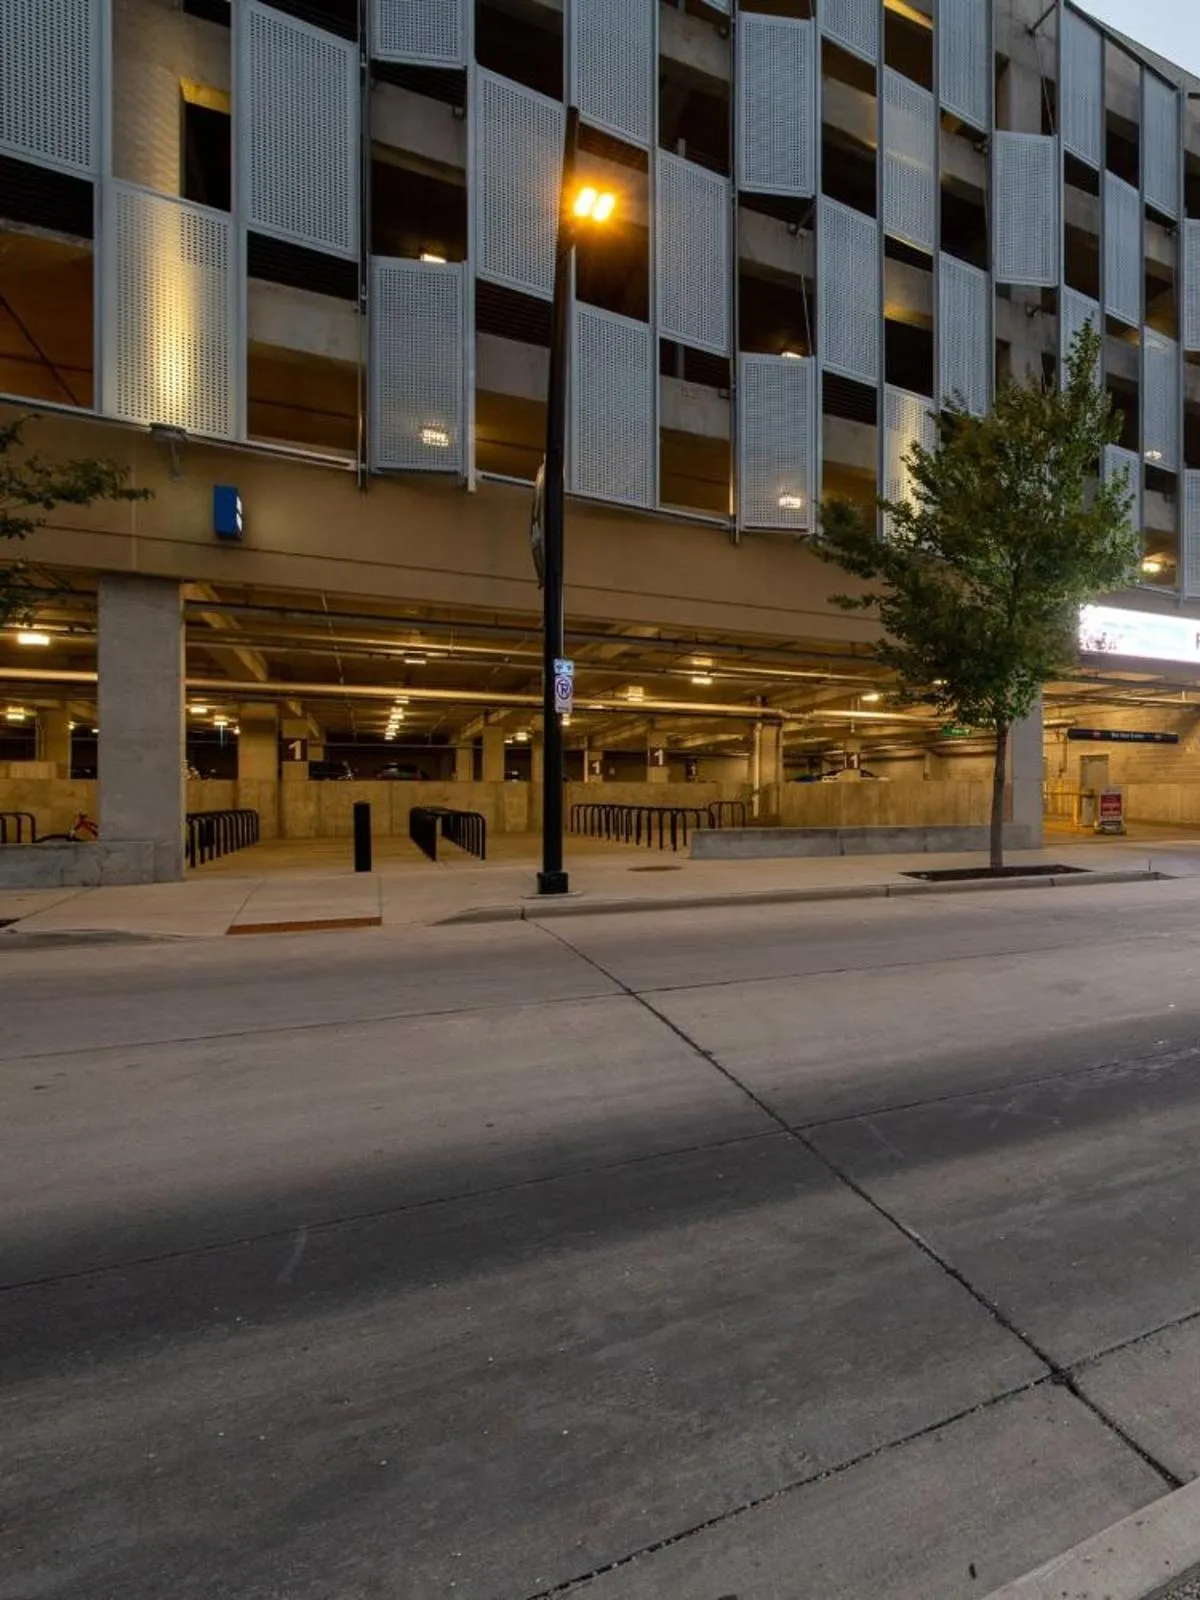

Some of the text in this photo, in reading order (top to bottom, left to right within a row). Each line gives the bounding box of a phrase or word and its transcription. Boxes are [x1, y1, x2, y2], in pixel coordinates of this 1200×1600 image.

[288, 740, 301, 760] 1
[654, 749, 664, 766] 1
[592, 761, 600, 774] 1
